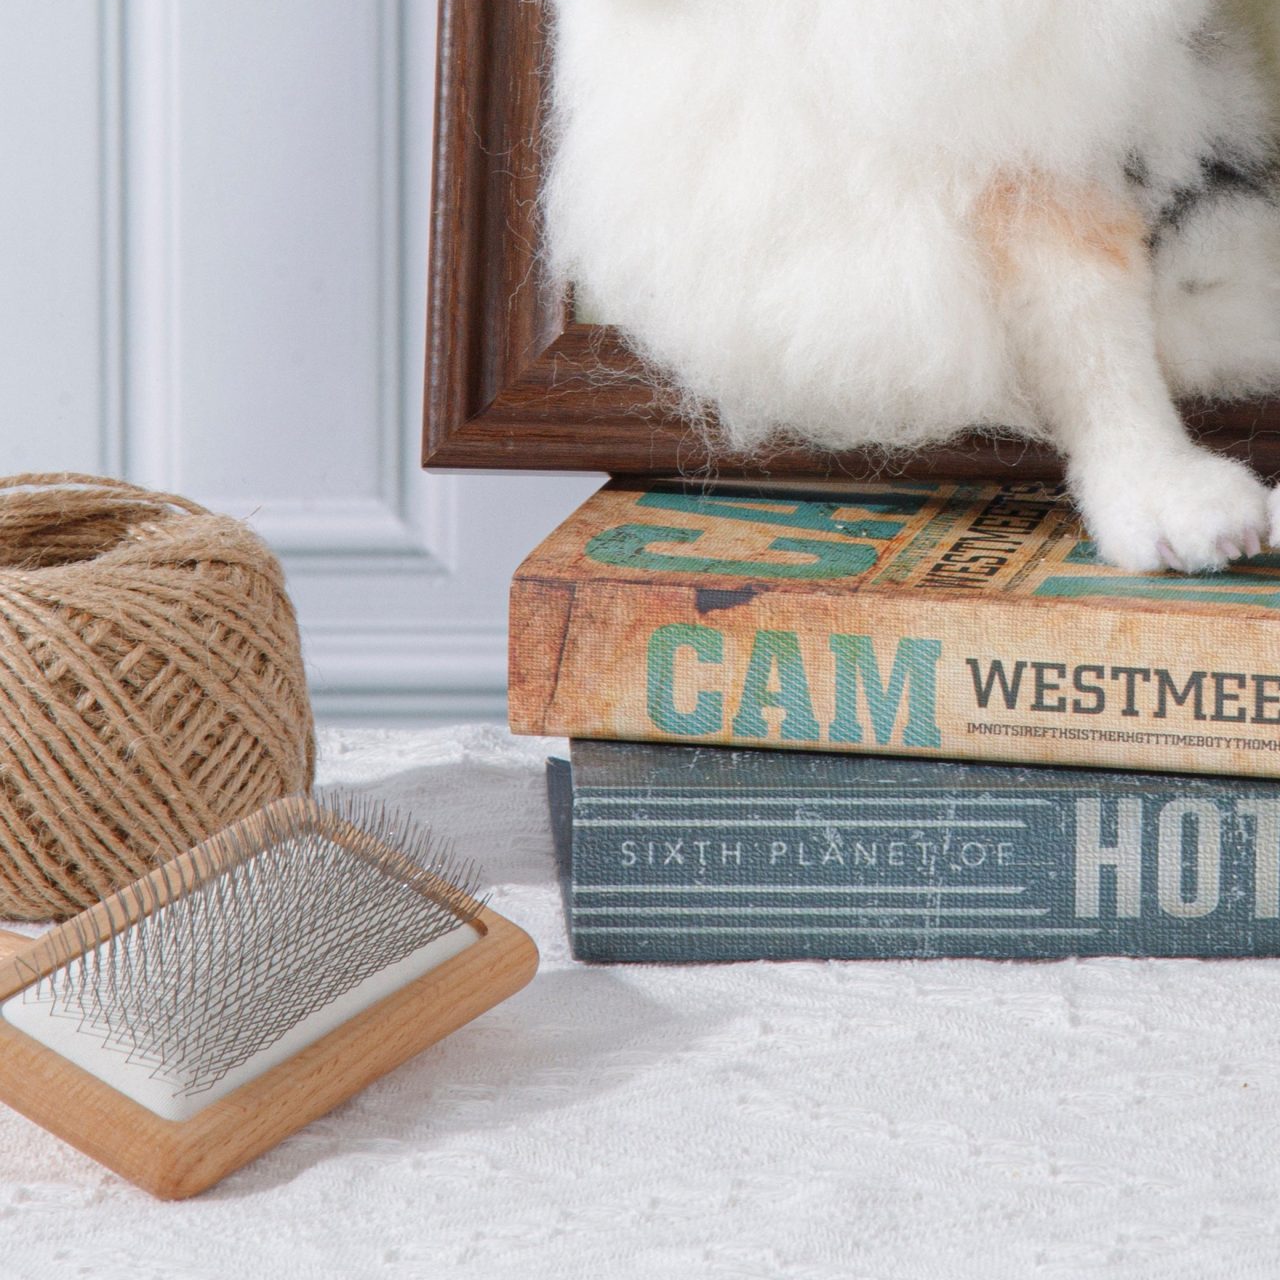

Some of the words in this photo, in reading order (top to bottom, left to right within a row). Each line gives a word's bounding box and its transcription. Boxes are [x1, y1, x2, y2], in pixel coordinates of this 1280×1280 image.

[646, 623, 942, 748] CAM
[620, 840, 742, 866] SIXTH
[769, 840, 933, 867] PLANET
[961, 841, 1013, 867] OF
